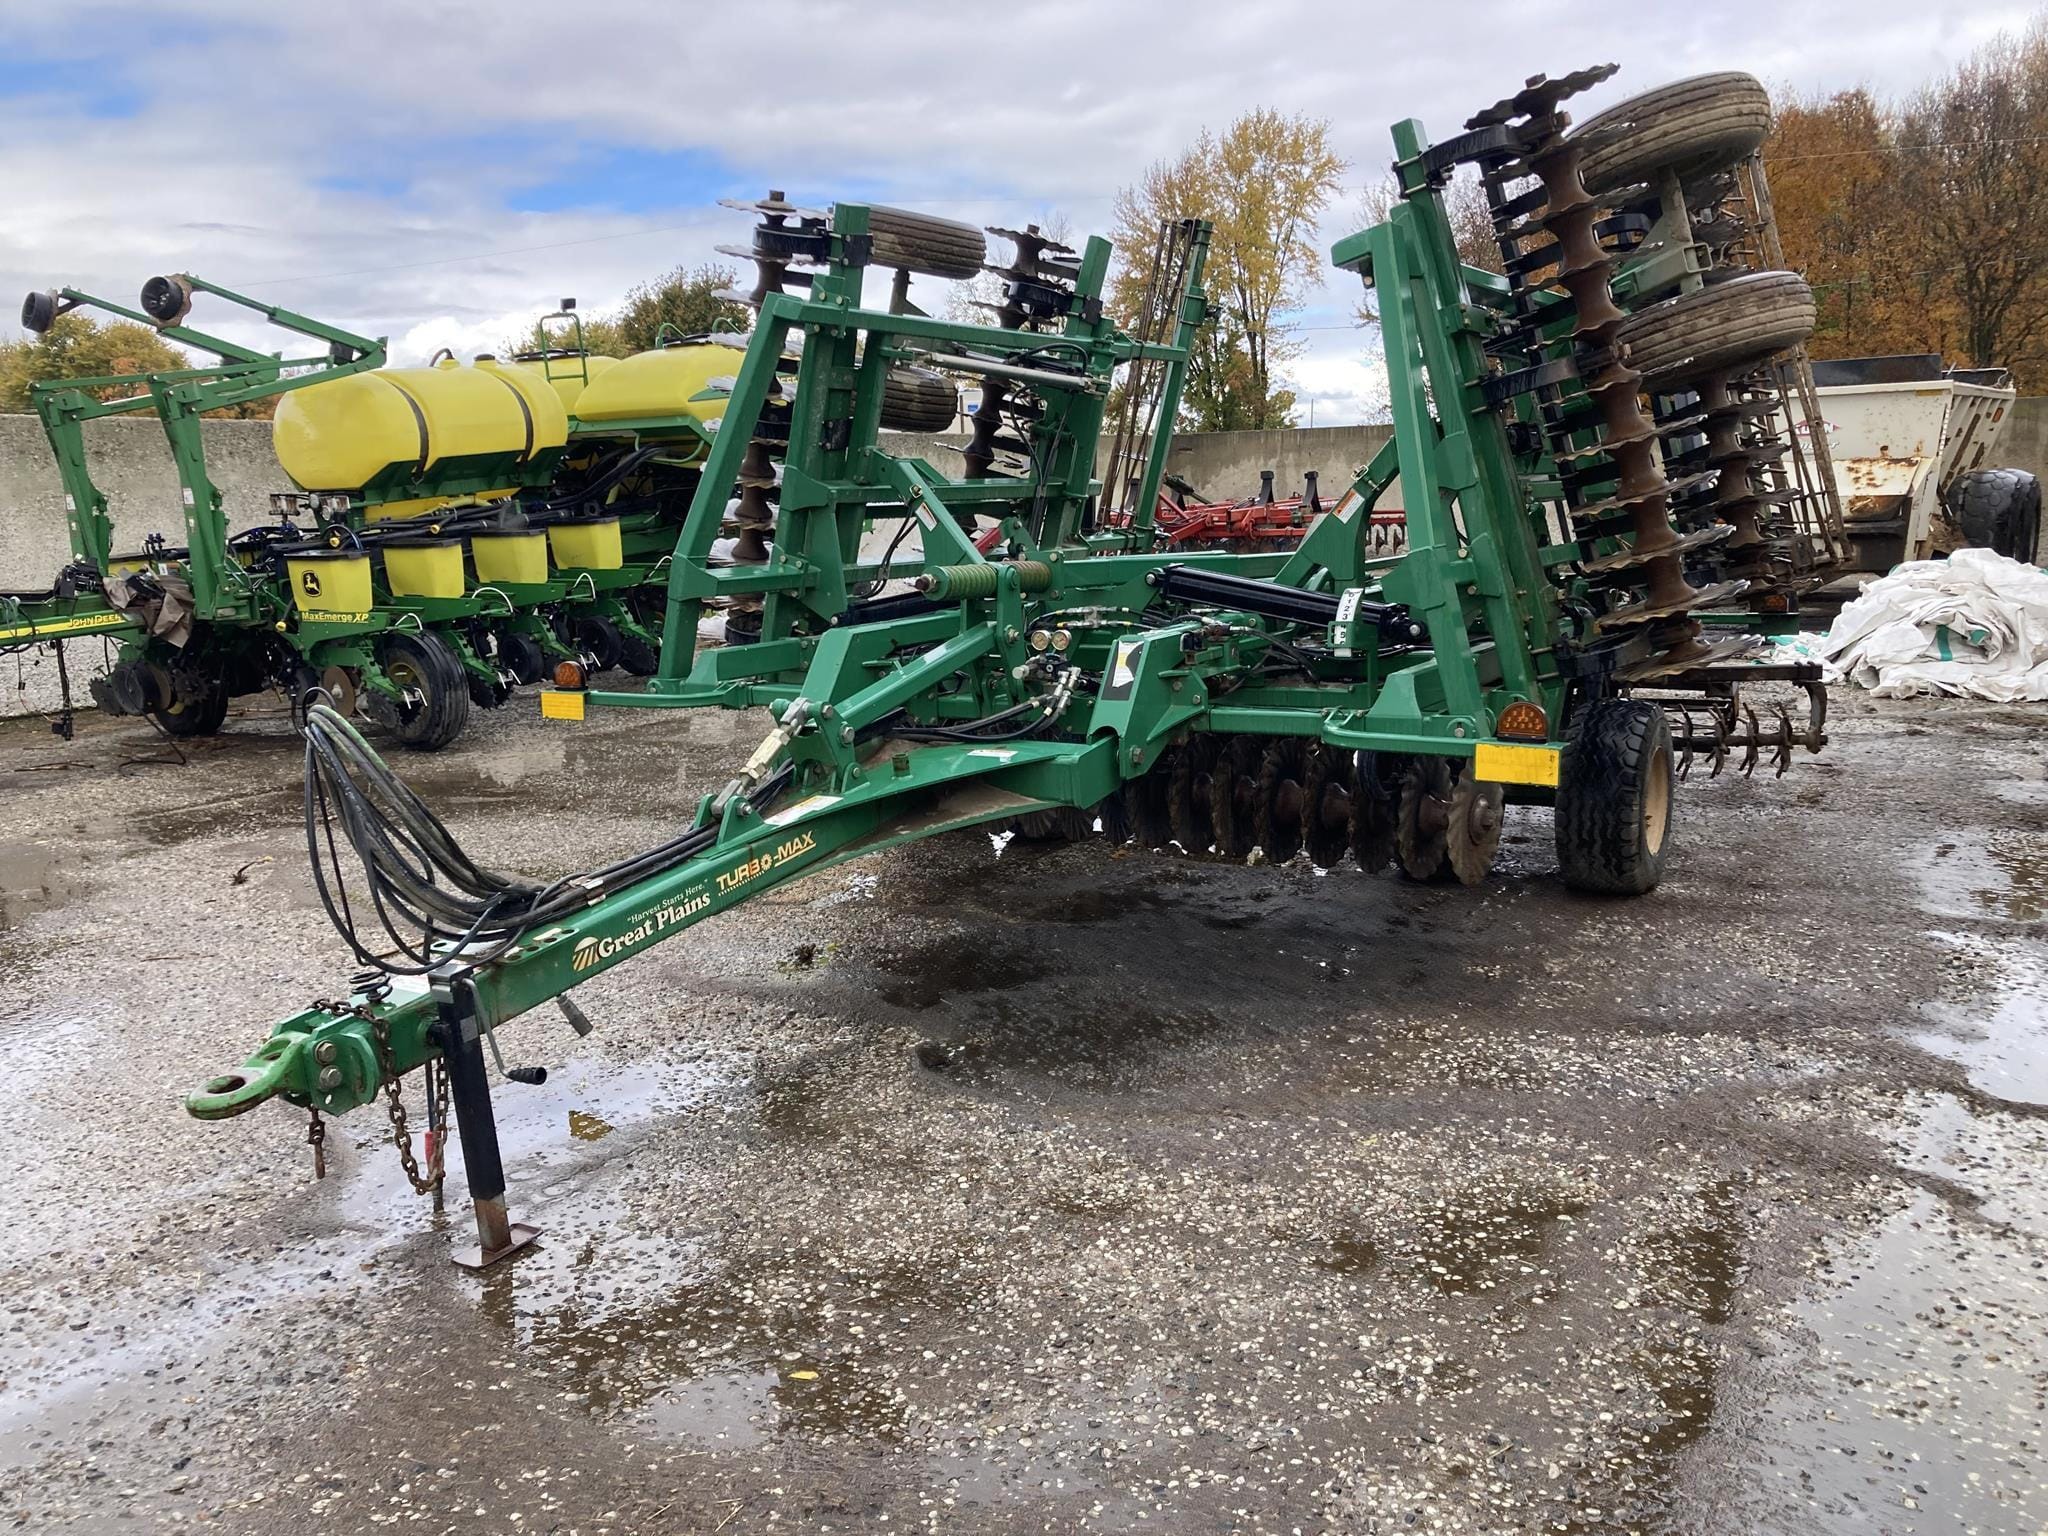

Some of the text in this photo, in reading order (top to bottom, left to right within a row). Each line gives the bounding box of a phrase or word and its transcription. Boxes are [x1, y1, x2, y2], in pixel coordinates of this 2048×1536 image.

[68, 616, 95, 628] JOHN
[301, 611, 369, 623] MaxEmerge XP
[661, 892, 684, 909] Starts
[598, 892, 711, 958] Great Plains
